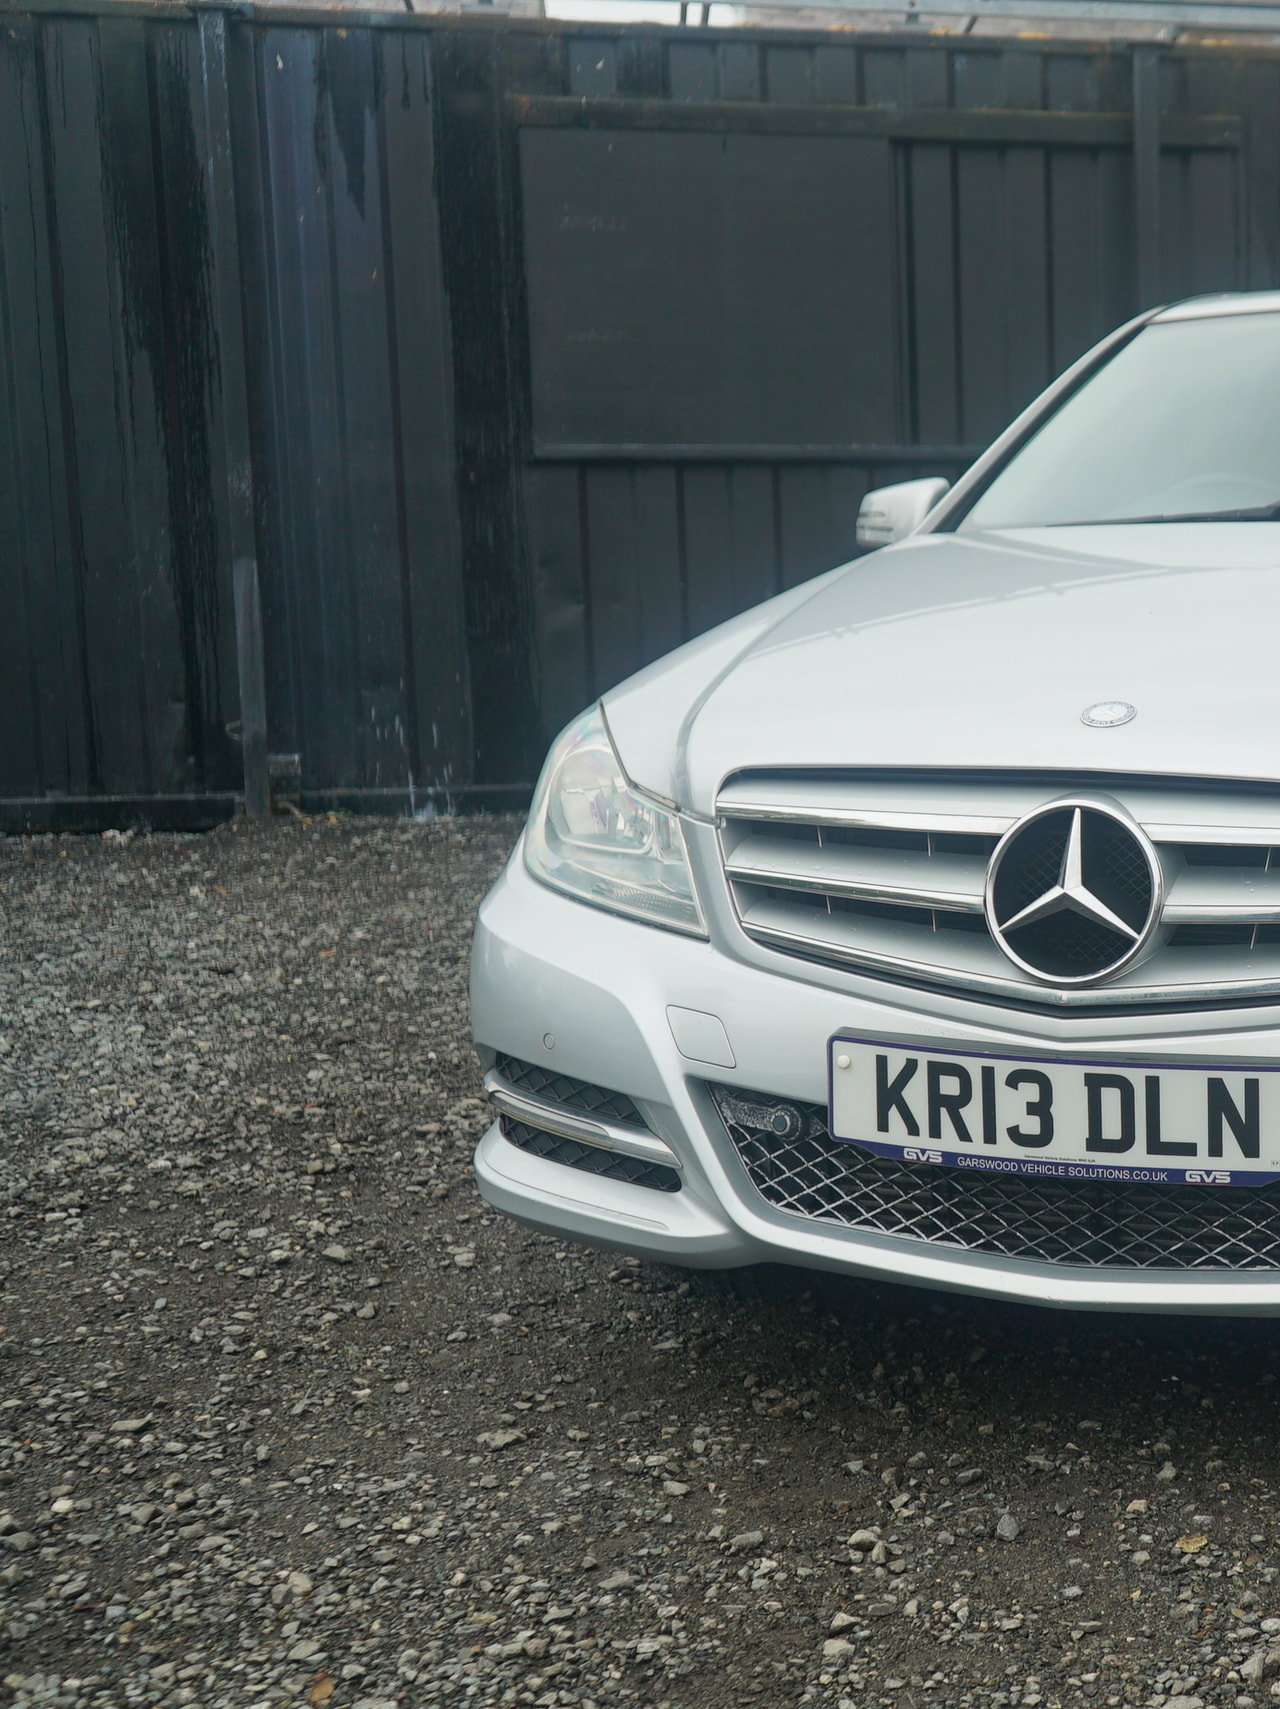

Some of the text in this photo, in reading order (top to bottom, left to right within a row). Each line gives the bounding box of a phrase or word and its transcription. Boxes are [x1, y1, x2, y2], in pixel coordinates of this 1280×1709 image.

[876, 1054, 1260, 1159] KR13 DLN
[903, 1147, 942, 1163] GVS
[957, 1157, 1018, 1171] GARSWOOD
[1021, 1162, 1065, 1176] VEHICLE
[1068, 1166, 1168, 1182] SOLUTIONS.CO.UK
[1185, 1171, 1231, 1184] GVS
